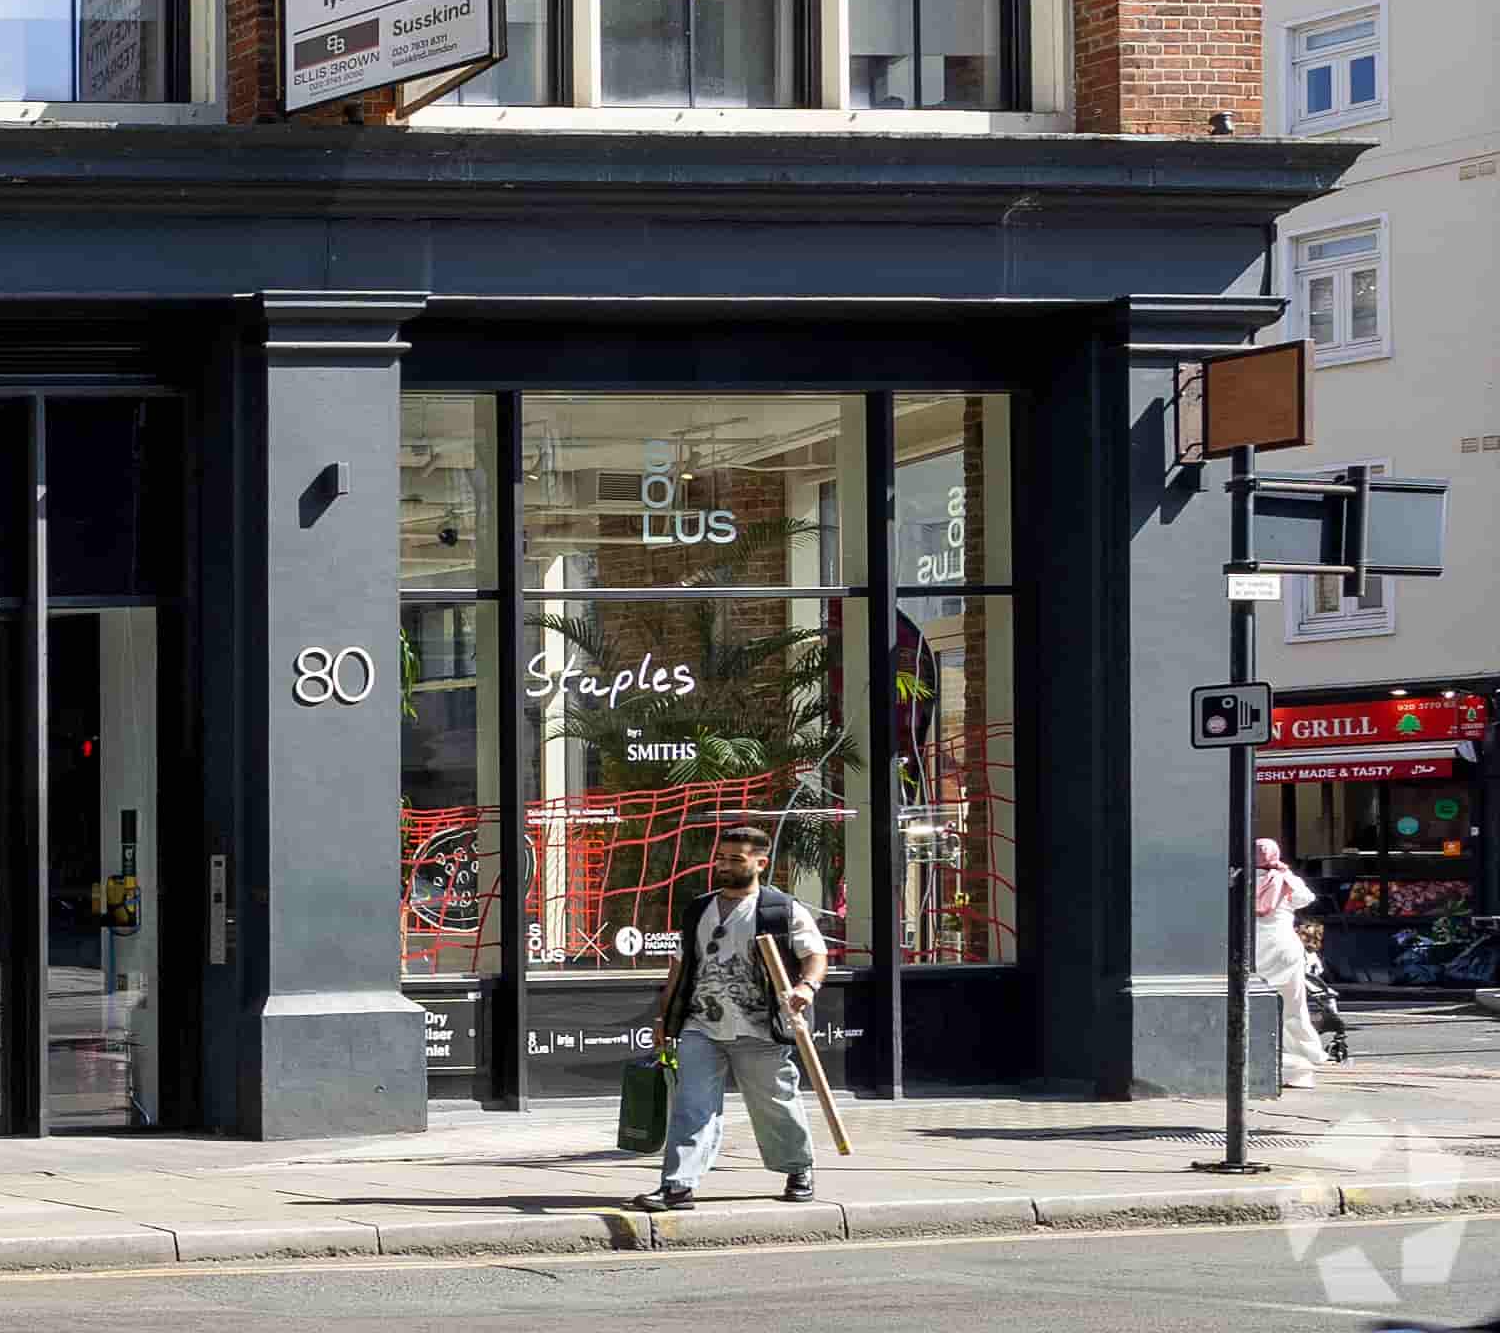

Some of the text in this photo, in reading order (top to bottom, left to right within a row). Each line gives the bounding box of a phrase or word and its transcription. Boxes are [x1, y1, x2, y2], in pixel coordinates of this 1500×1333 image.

[293, 66, 327, 86] ELLIS
[330, 51, 380, 76] BROWN
[295, 646, 375, 703] 80
[526, 652, 696, 709] Staples
[1291, 716, 1378, 739] GRILL
[627, 743, 697, 761] SMITHS
[1299, 768, 1336, 780] MADE
[1339, 767, 1348, 778] &
[1353, 765, 1394, 777] TASTY
[424, 1011, 448, 1028] Dry
